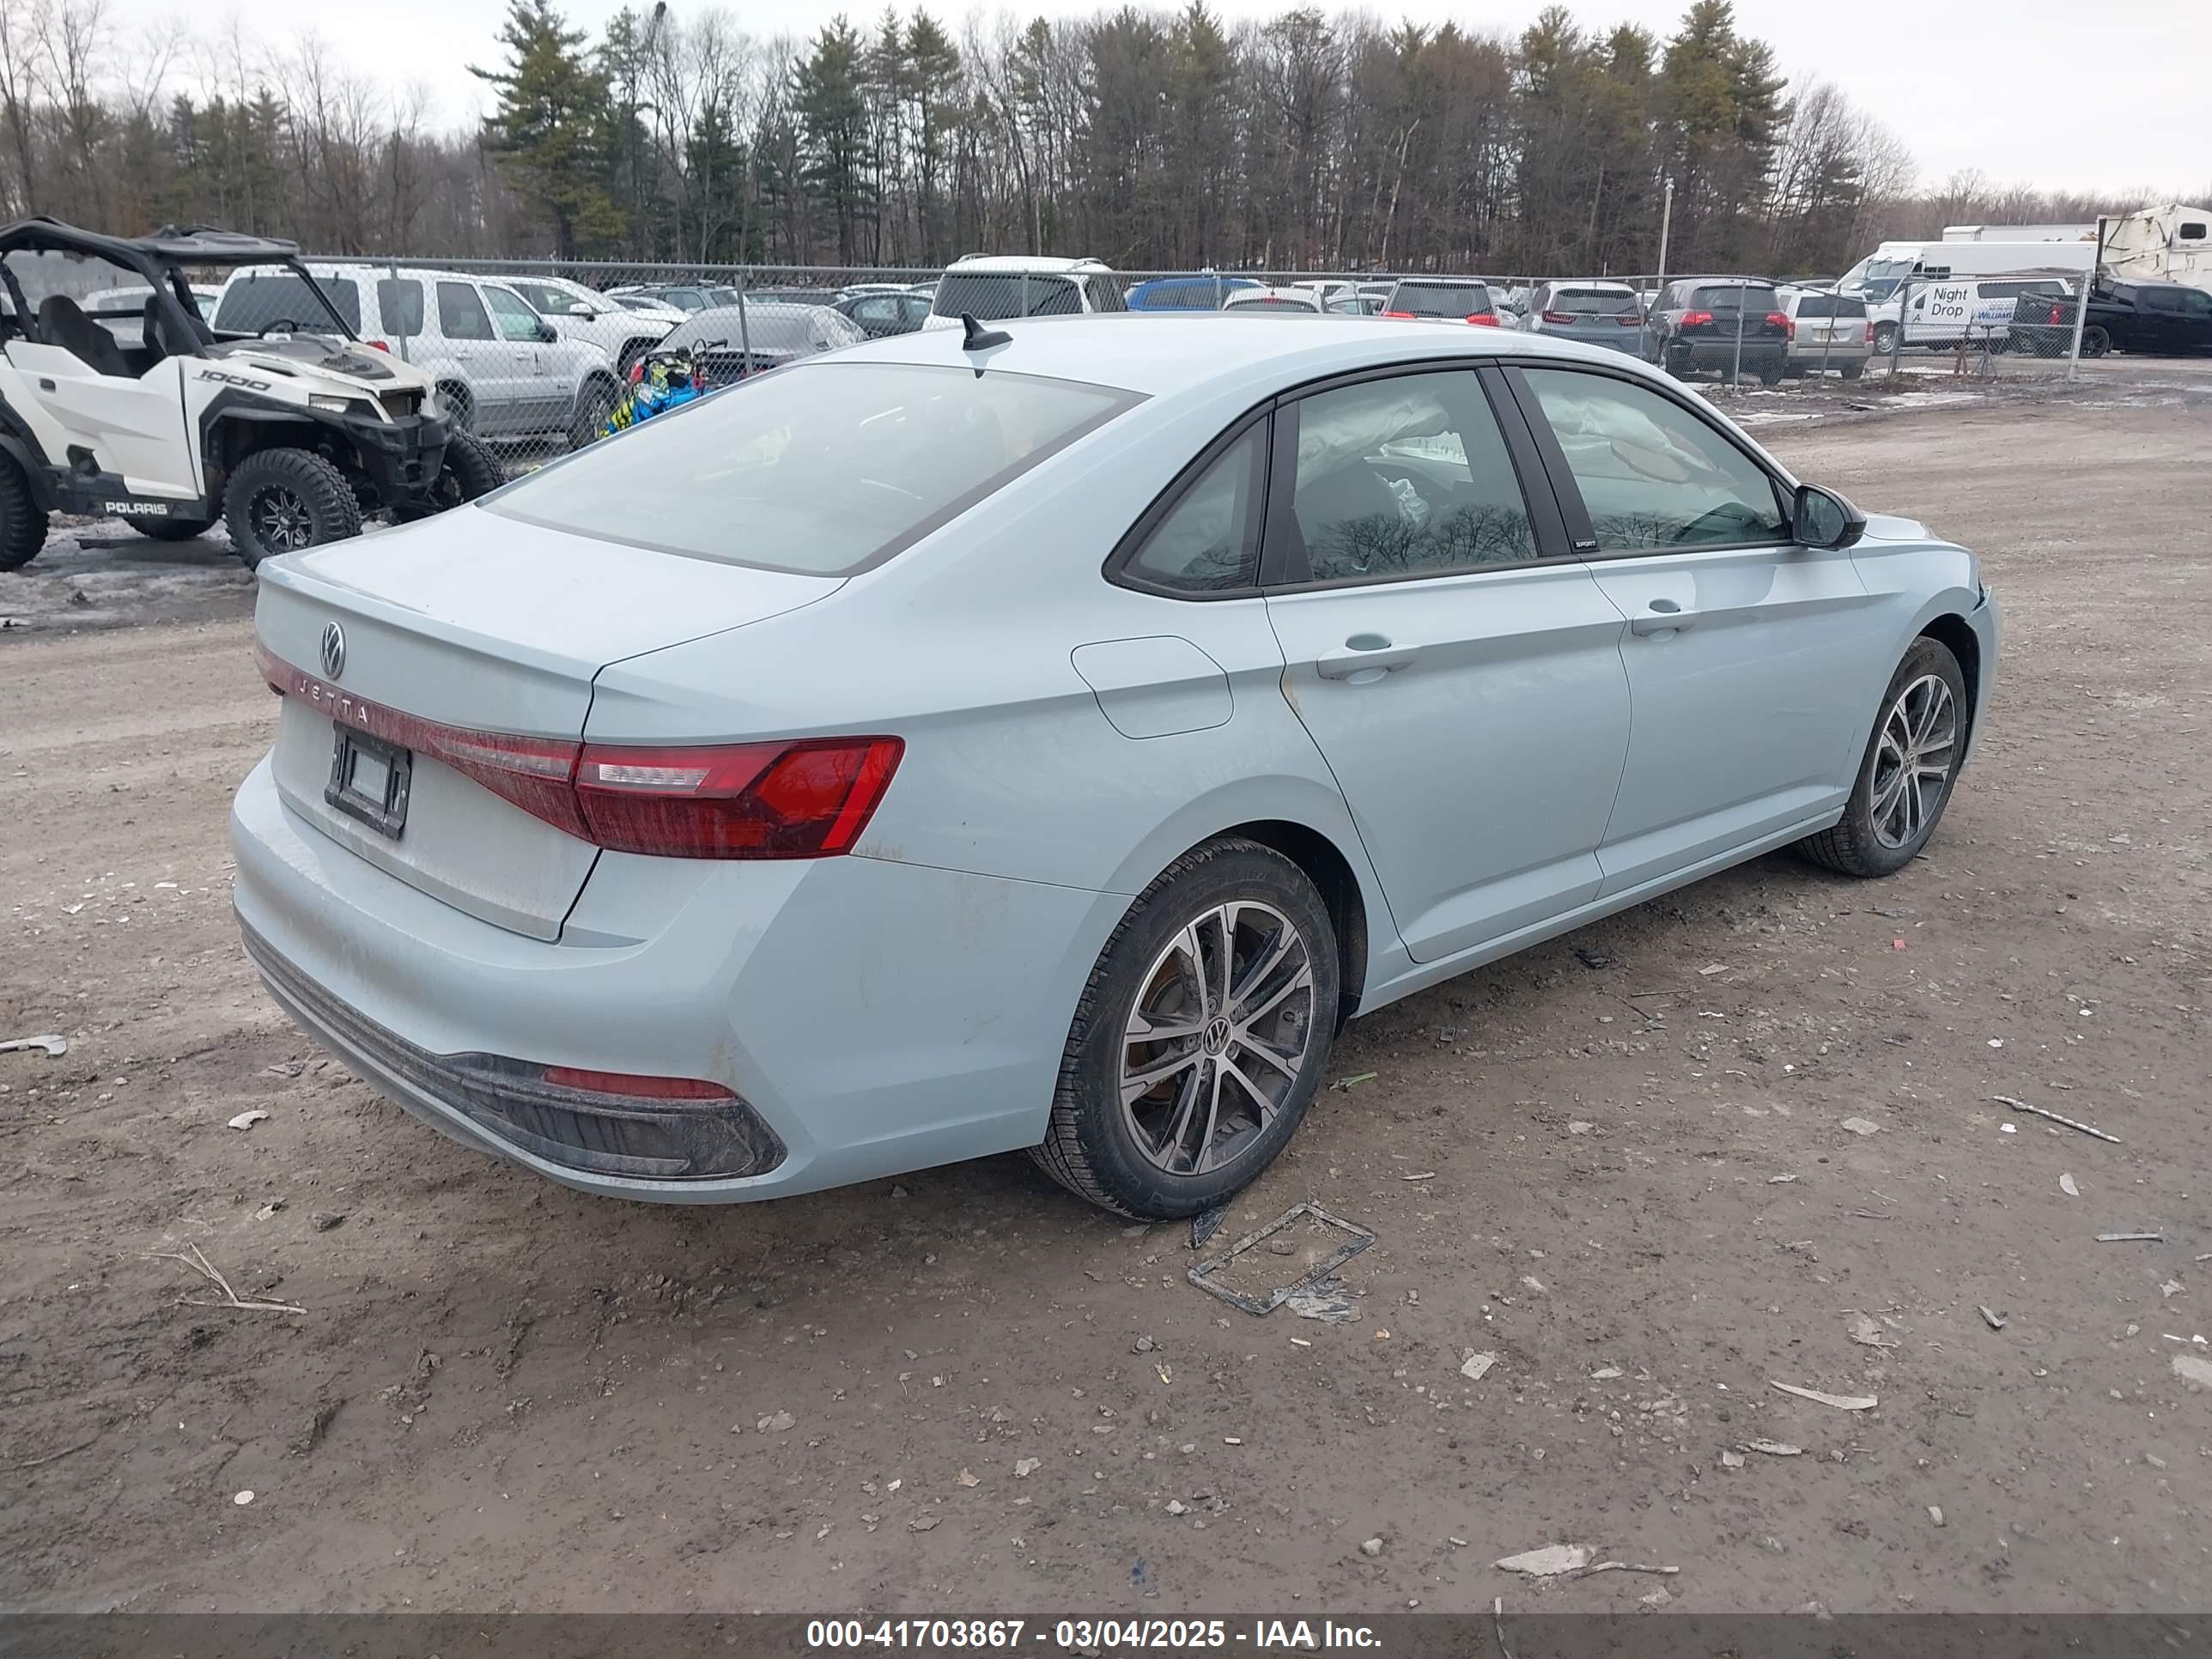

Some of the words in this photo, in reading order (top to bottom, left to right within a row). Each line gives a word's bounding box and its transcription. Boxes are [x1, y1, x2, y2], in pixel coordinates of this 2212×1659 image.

[1934, 288, 1968, 303] Night
[1931, 303, 1964, 319] Drop
[199, 369, 272, 392] 1000
[105, 501, 167, 515] POLARIS
[300, 679, 368, 724] JETTA
